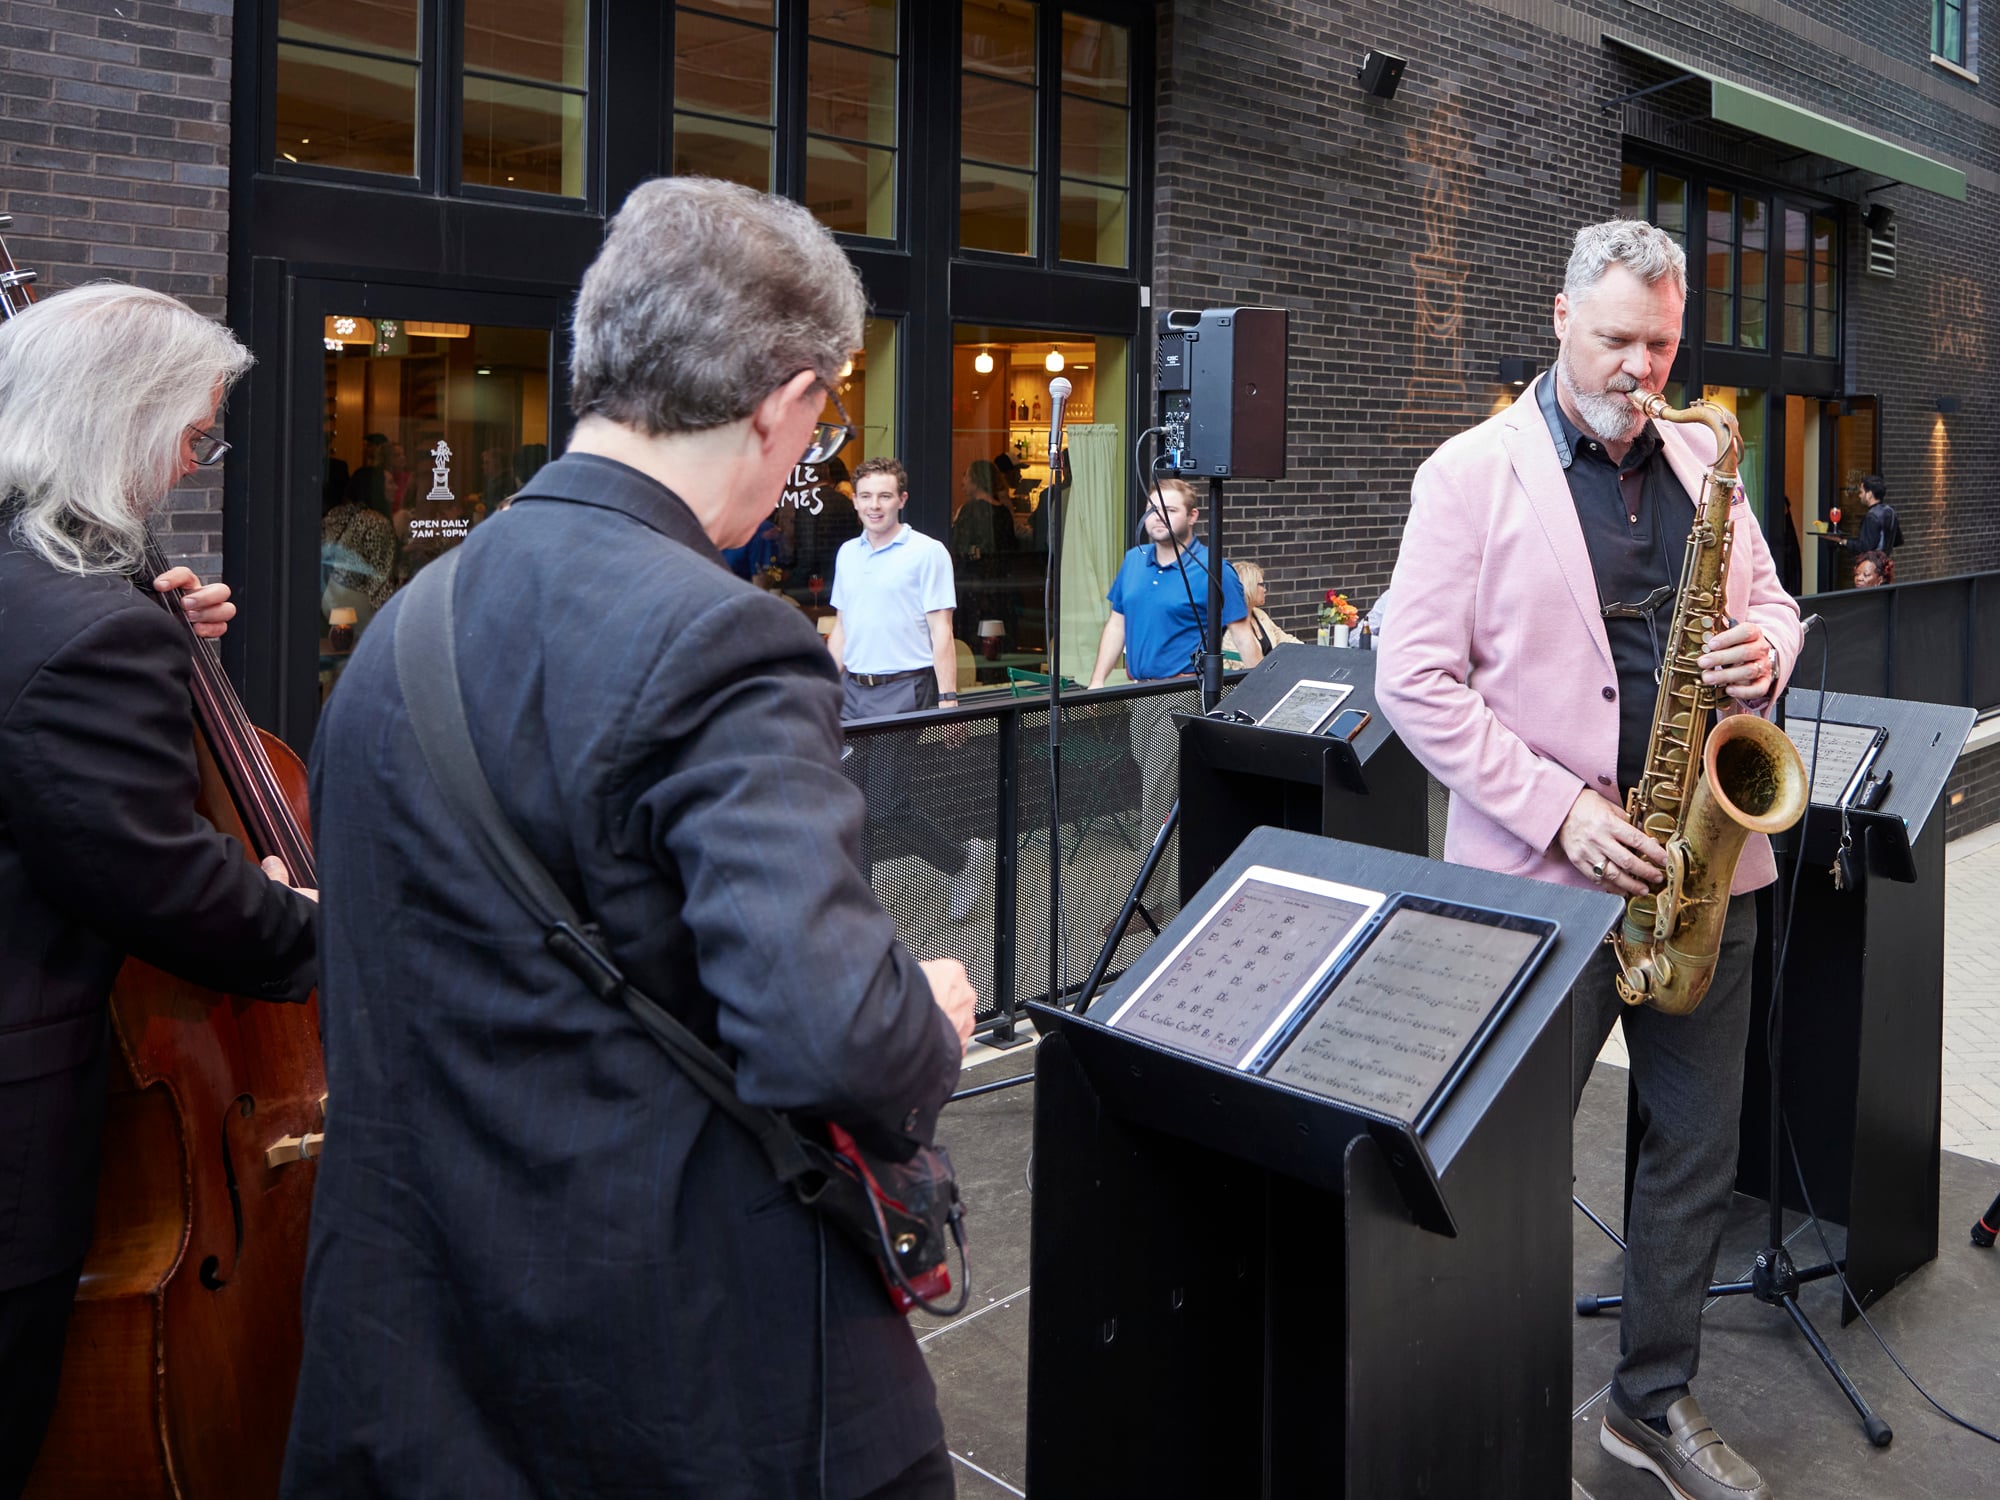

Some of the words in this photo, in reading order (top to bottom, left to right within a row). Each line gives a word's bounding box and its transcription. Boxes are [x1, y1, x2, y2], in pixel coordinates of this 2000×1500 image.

[774, 487, 824, 515] MES
[410, 519, 439, 528] OPEN
[441, 519, 469, 528] DAILY
[411, 529, 434, 538] 7AM
[442, 528, 468, 538] 10PM
